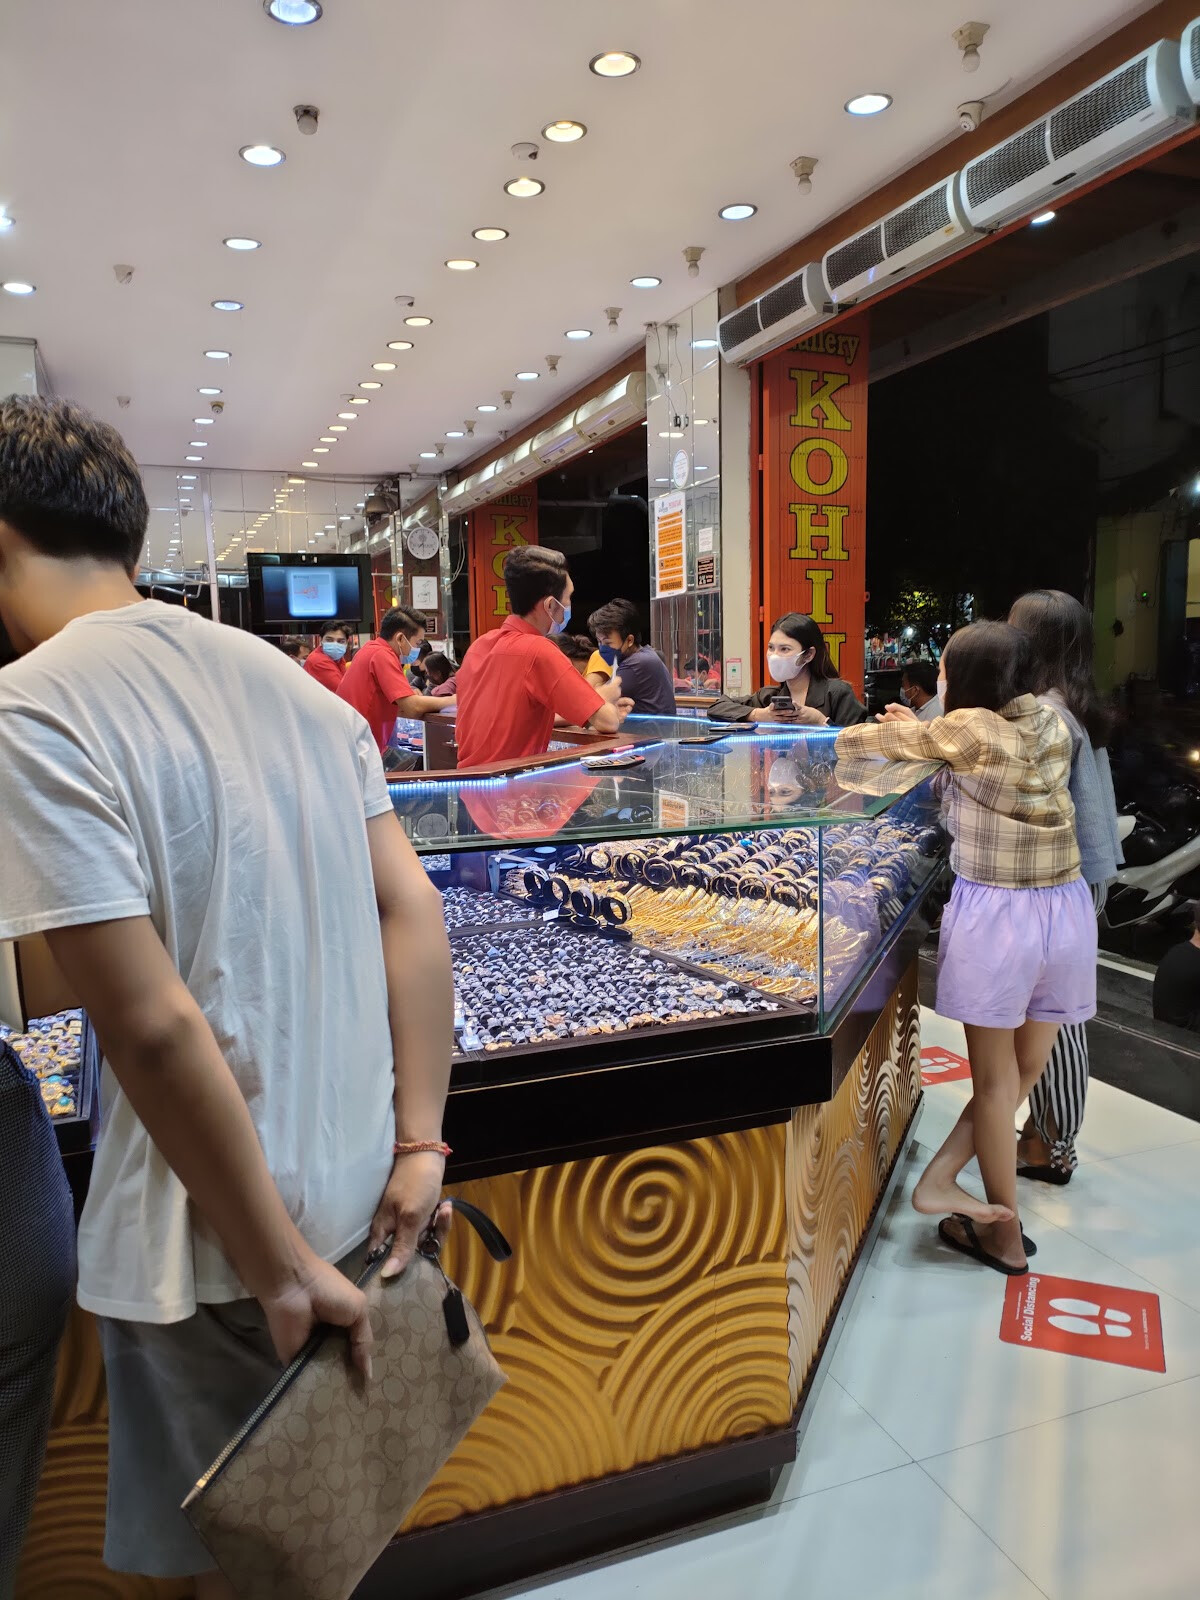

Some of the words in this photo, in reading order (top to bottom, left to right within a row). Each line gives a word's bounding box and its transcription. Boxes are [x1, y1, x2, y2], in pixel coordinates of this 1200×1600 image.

[789, 331, 860, 366] allery
[492, 493, 533, 512] allery
[1023, 1277, 1040, 1315] Distancing
[1020, 1316, 1033, 1341] Social
